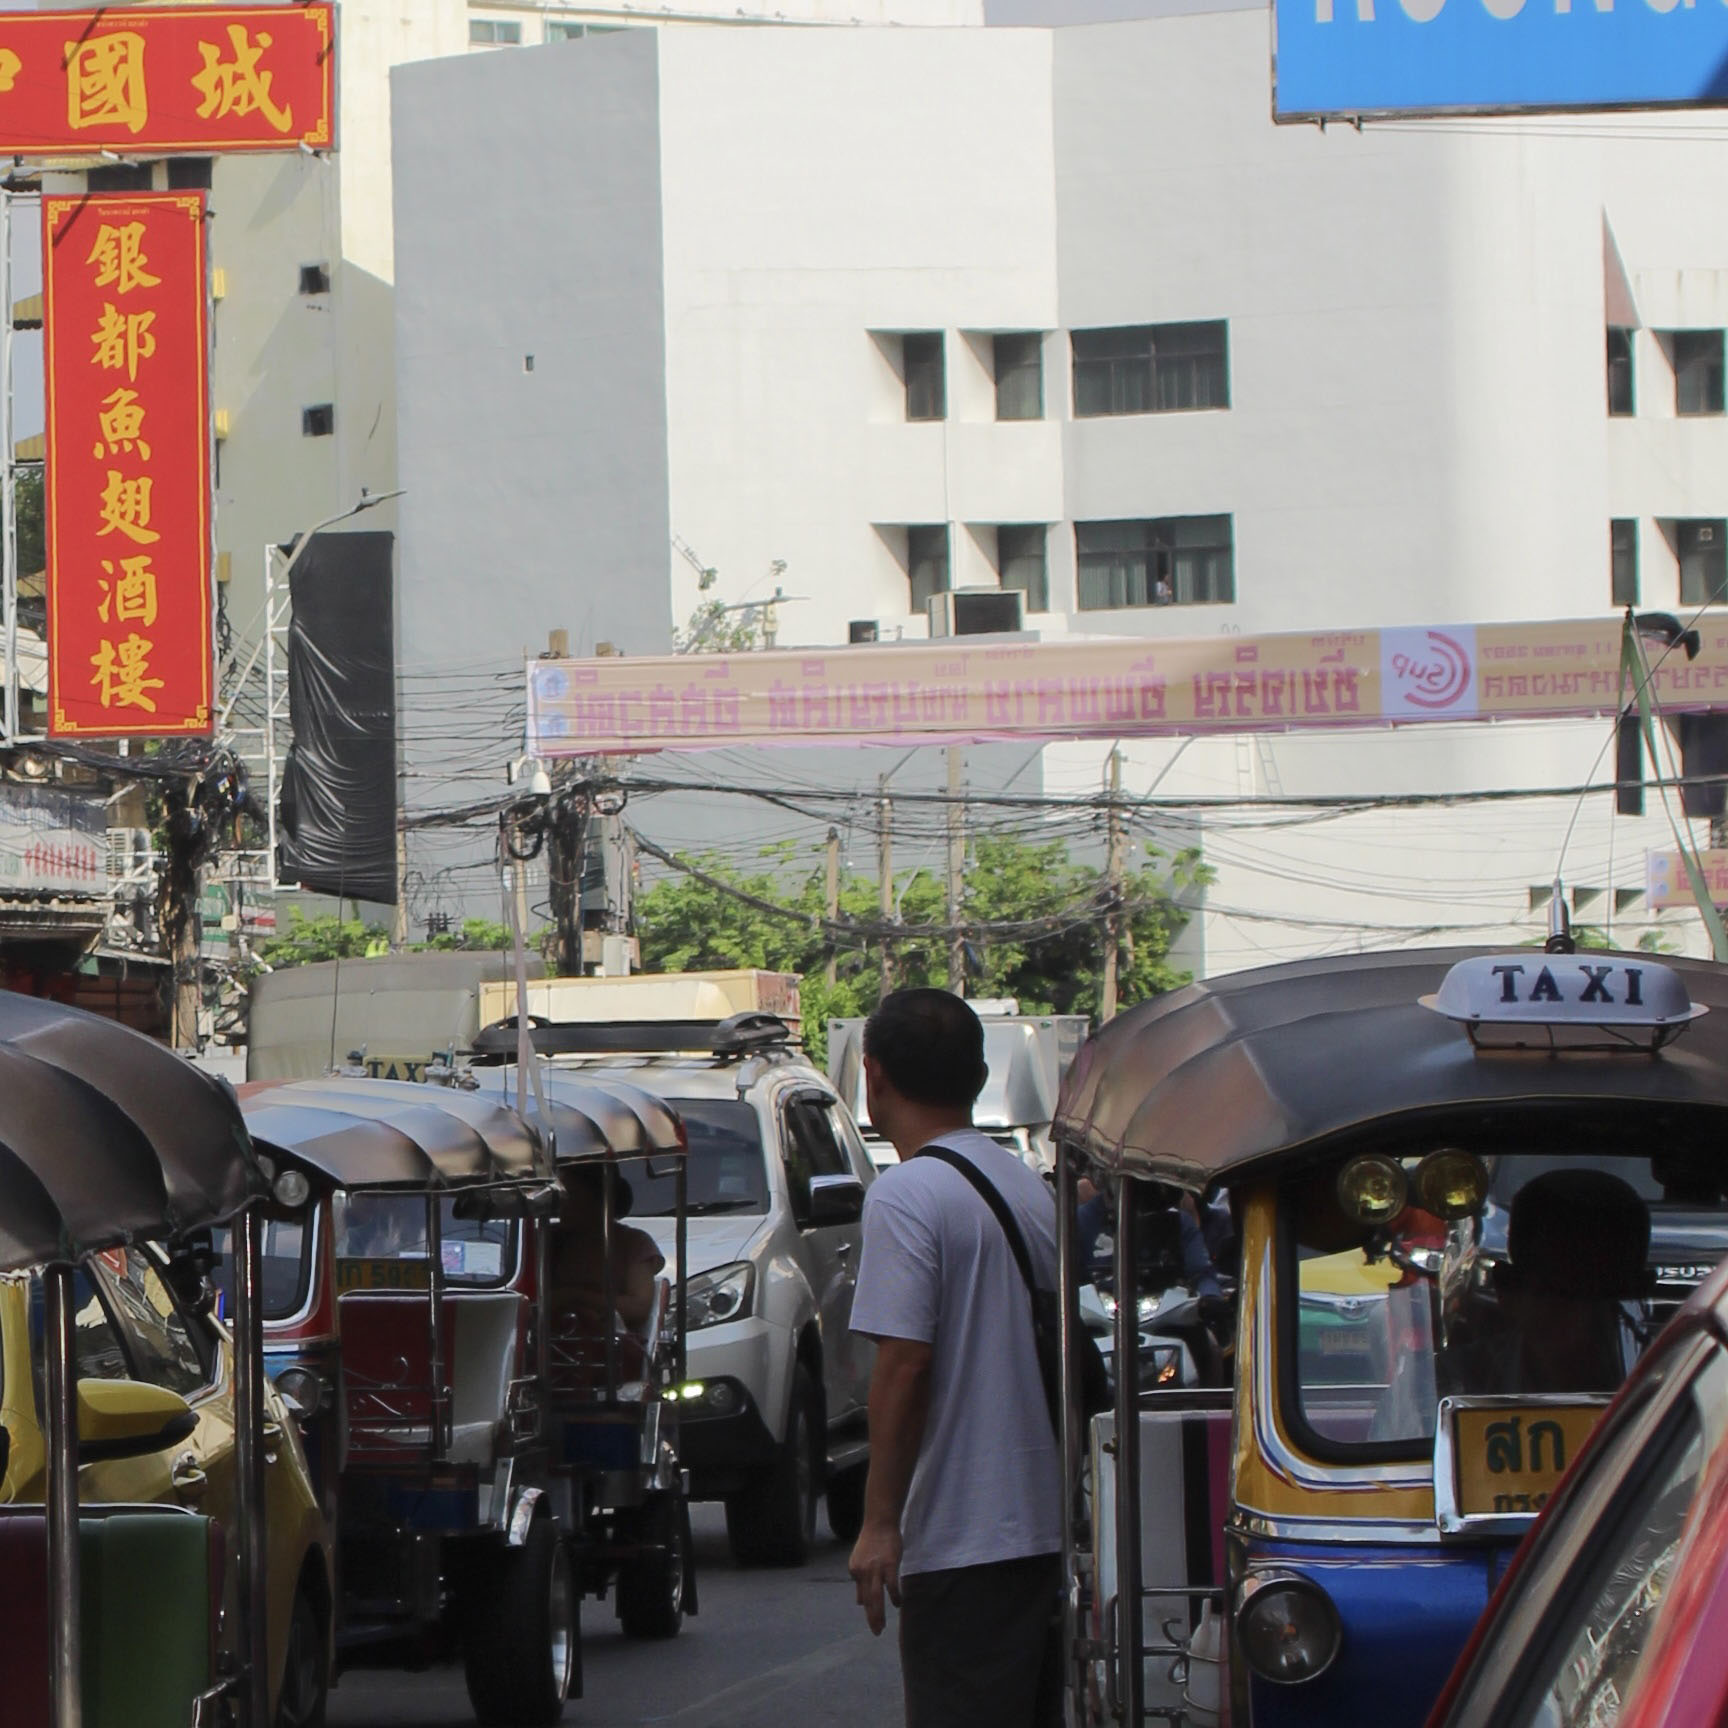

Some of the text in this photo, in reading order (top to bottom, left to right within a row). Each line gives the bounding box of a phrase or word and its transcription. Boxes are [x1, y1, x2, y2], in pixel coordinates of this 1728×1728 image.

[83, 221, 165, 714] 銀都魚翅酒樓
[1491, 963, 1644, 1007] TAXI
[1656, 1265, 1717, 1278] ISUZ
[1485, 1415, 1564, 1473] สก
